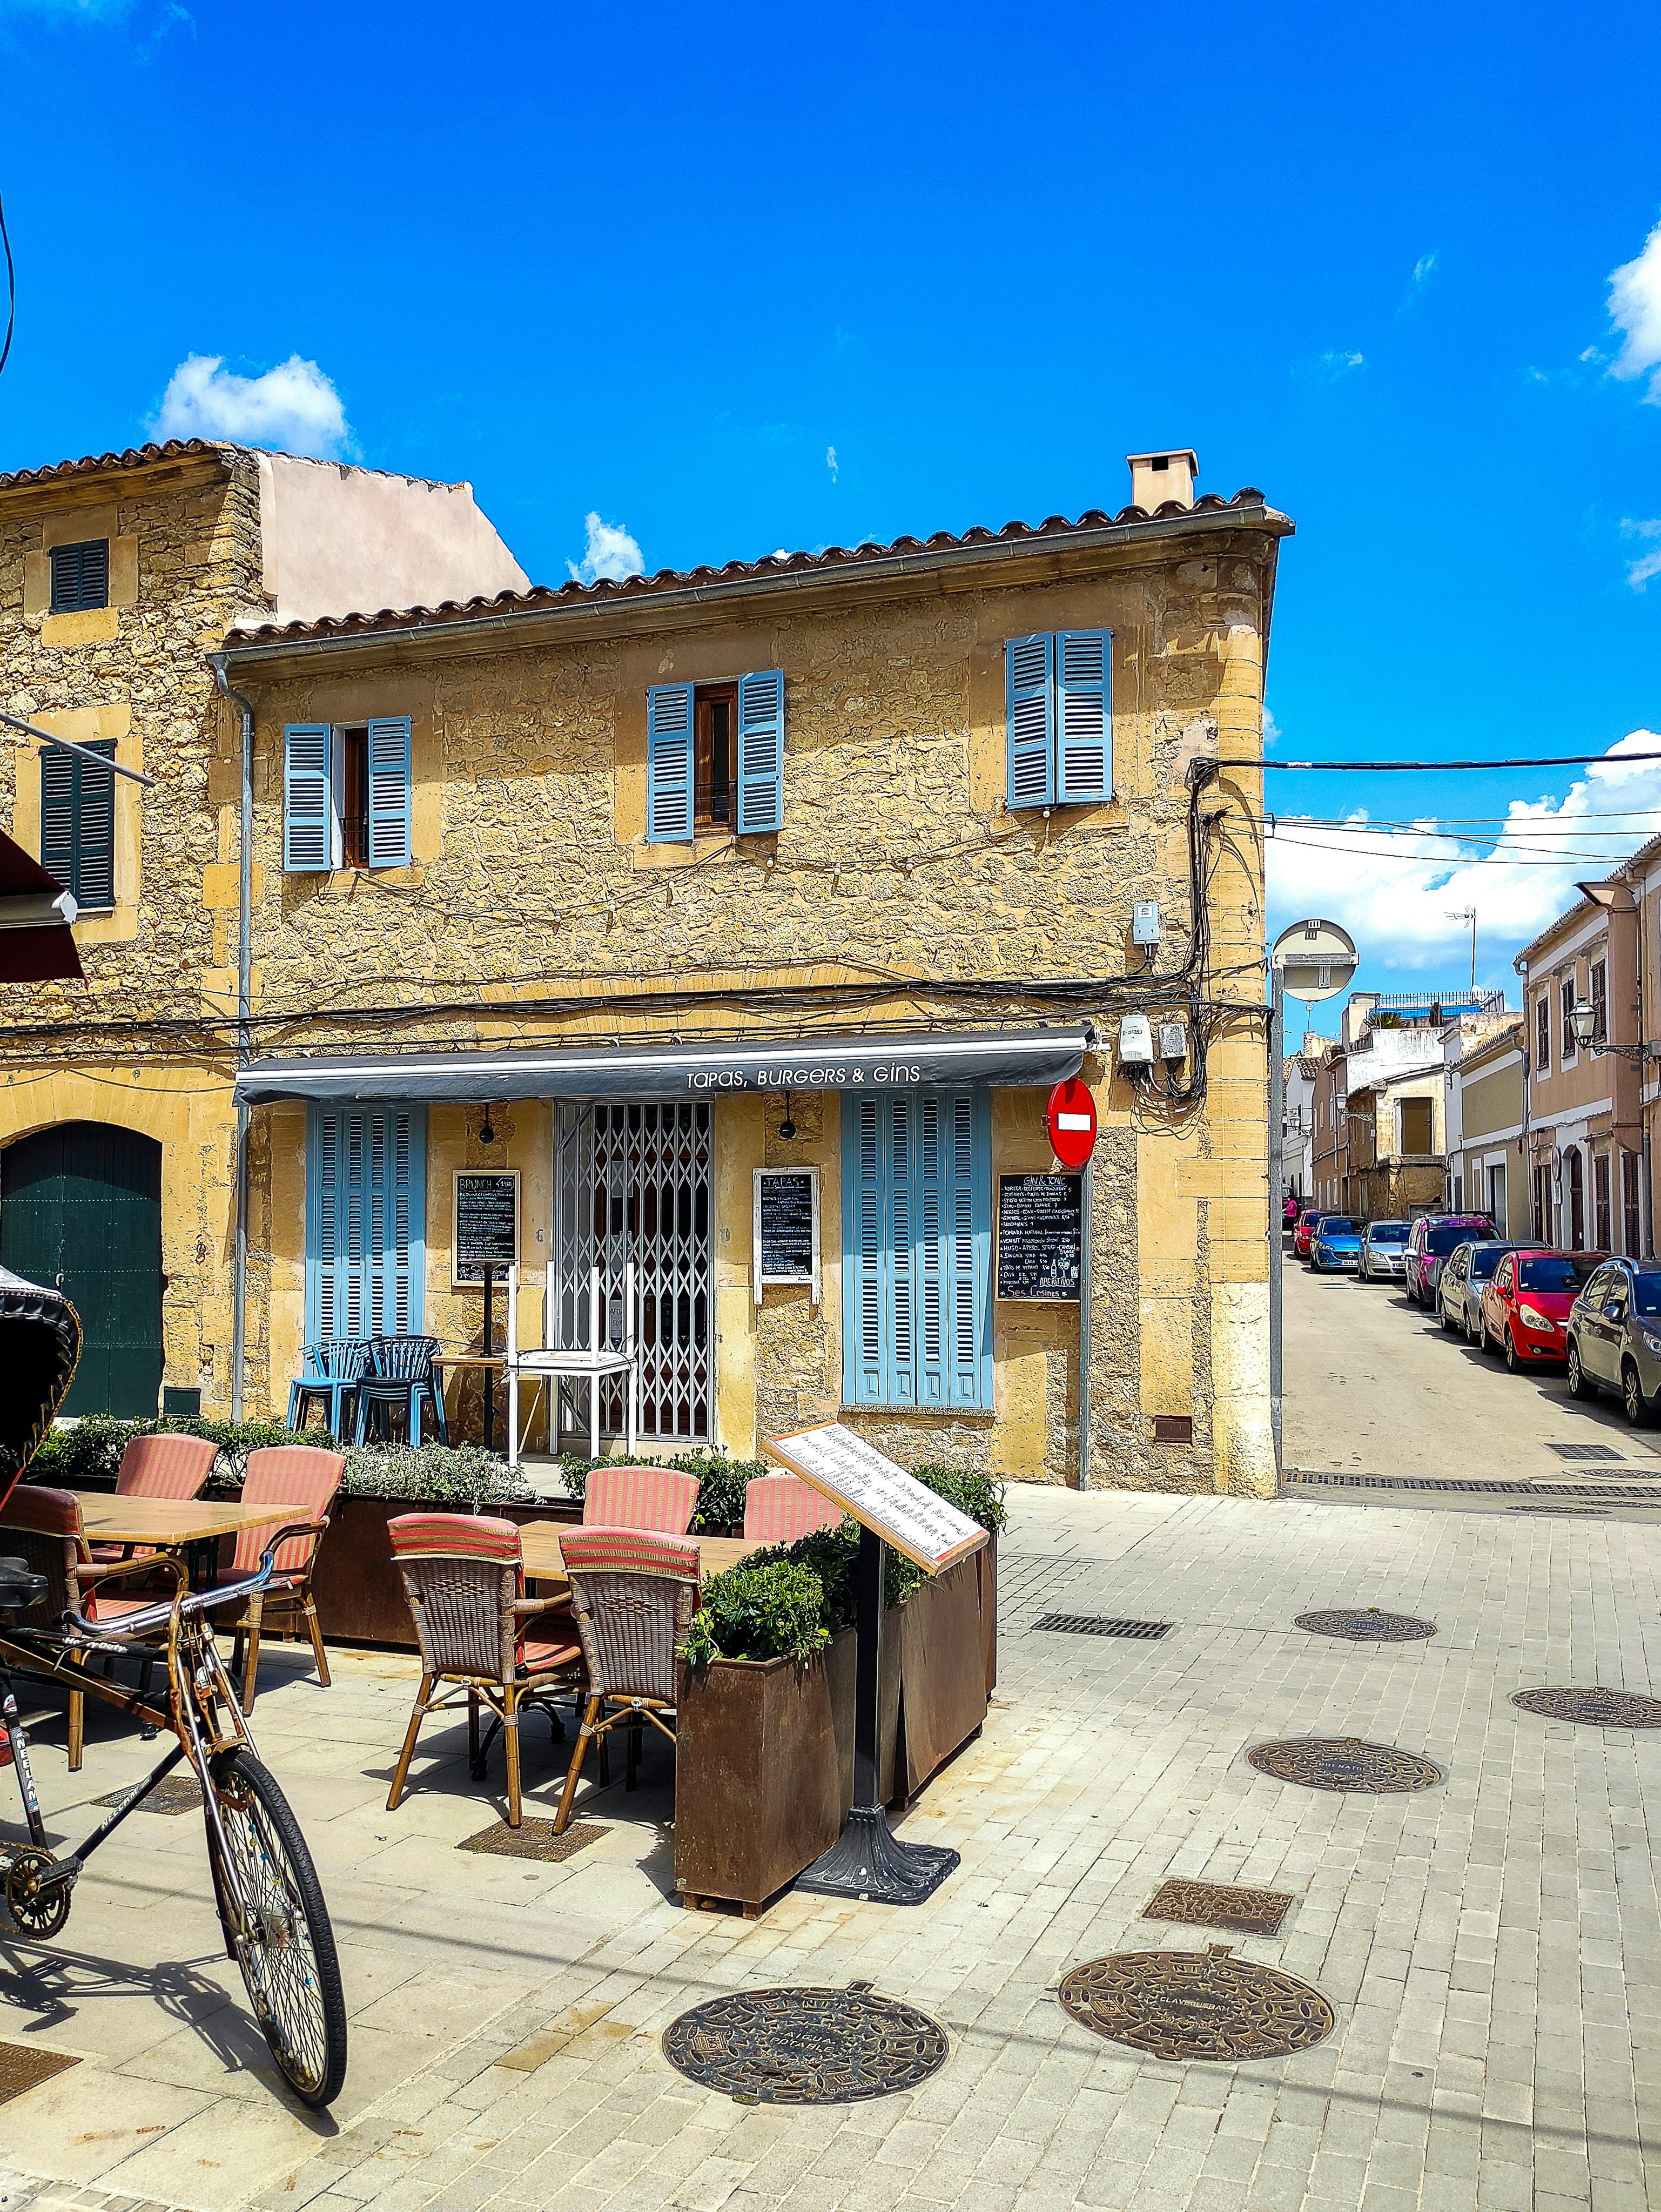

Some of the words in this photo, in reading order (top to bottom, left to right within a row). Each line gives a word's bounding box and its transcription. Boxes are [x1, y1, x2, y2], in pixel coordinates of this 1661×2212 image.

[852, 1068, 865, 1083] &
[460, 1179, 492, 1190] BRUNCH
[766, 1177, 799, 1187] TAPAS
[1023, 1175, 1038, 1185] GIN
[769, 2036, 835, 2053] POTABLE
